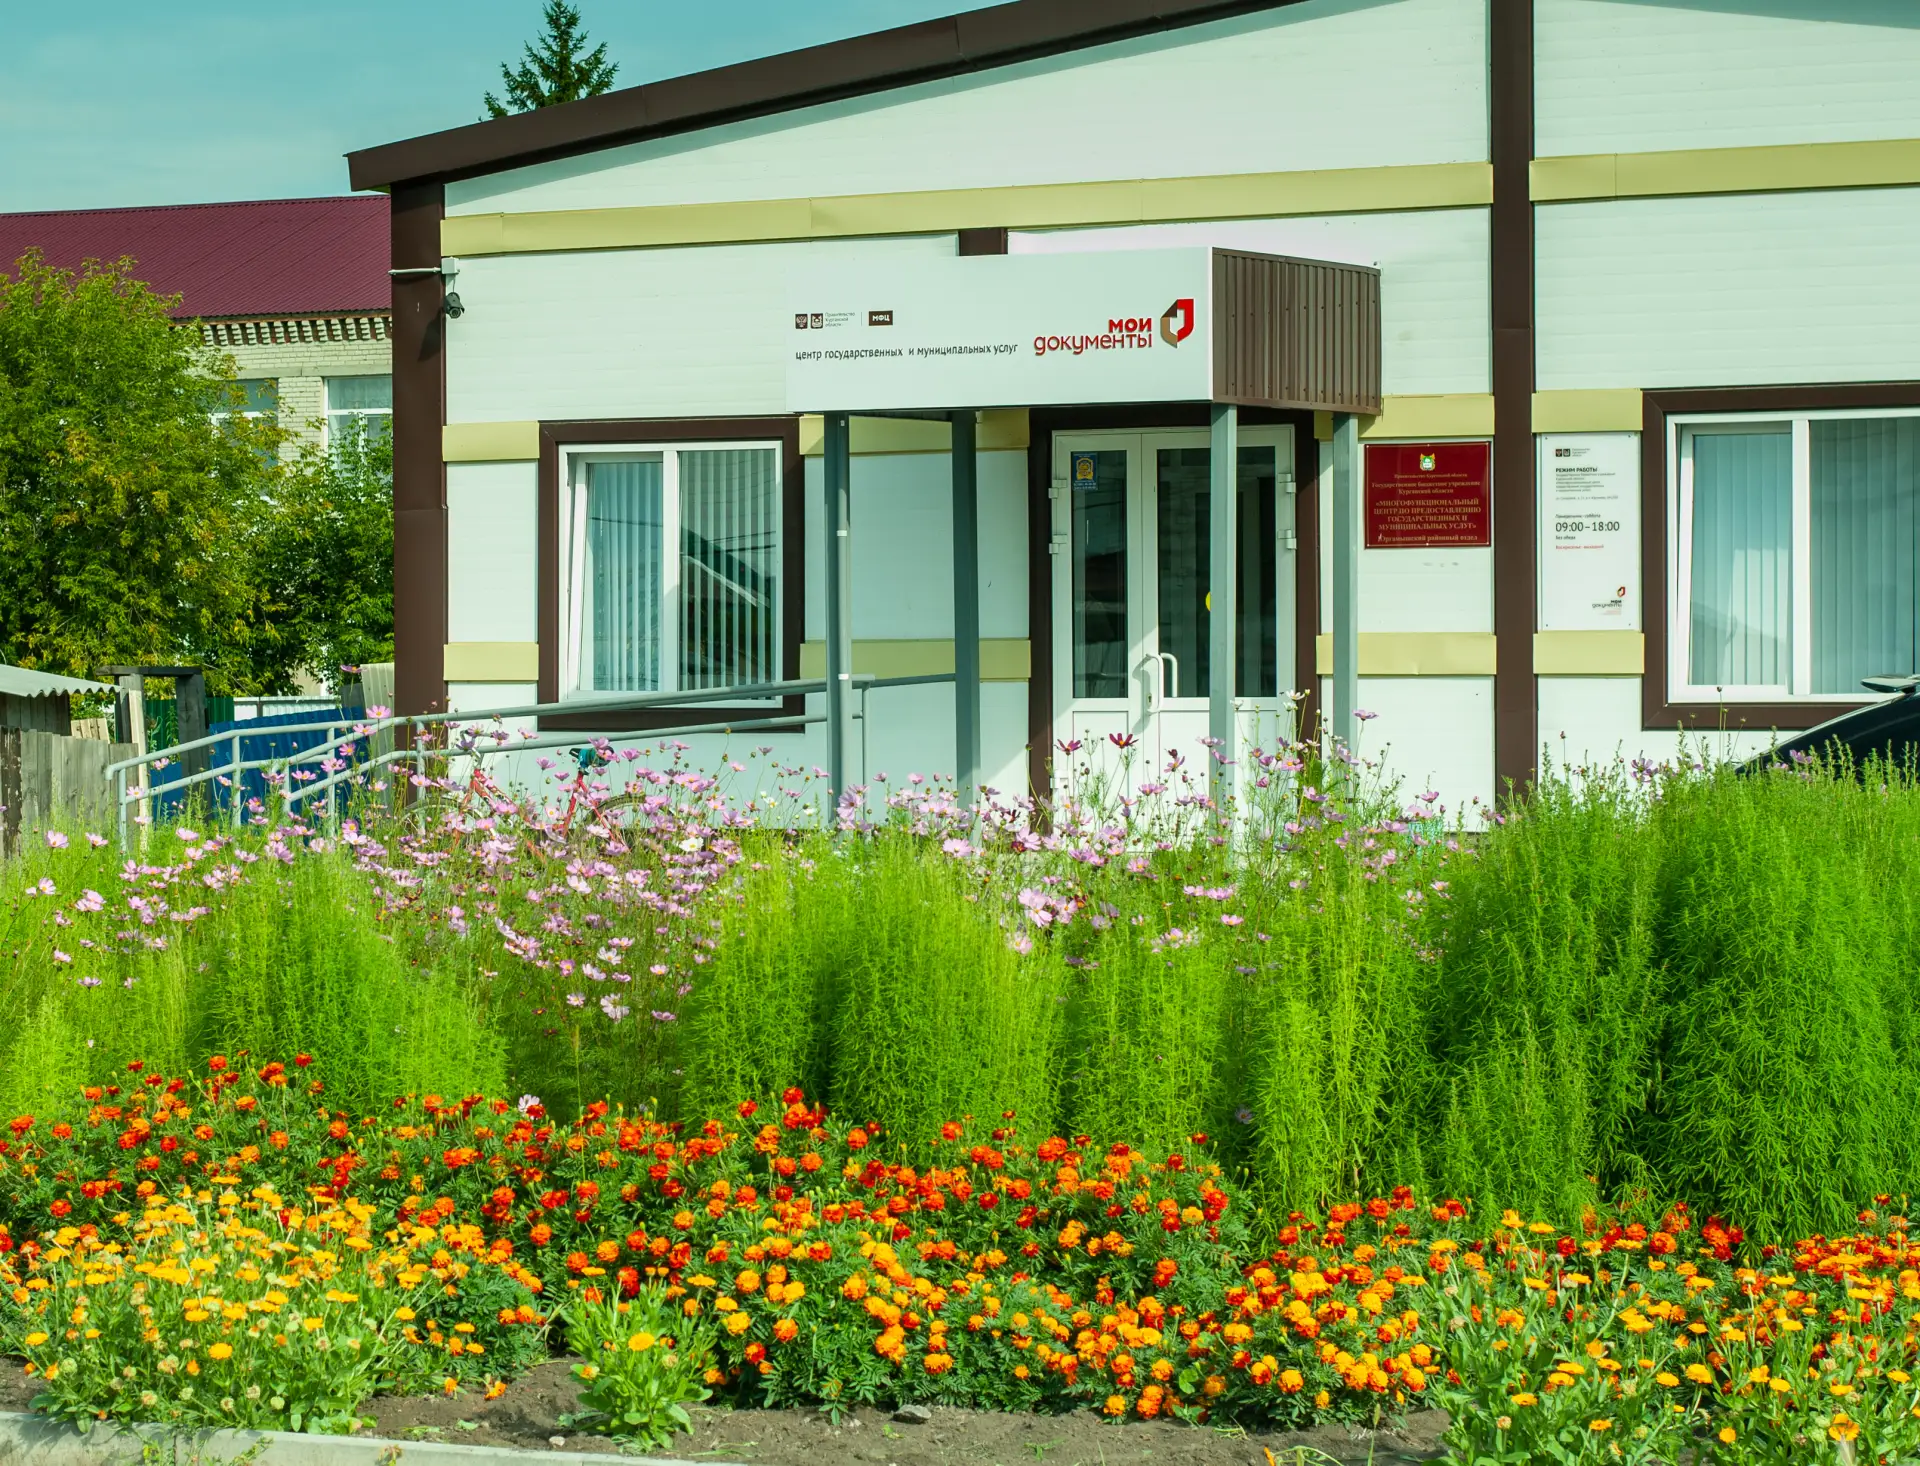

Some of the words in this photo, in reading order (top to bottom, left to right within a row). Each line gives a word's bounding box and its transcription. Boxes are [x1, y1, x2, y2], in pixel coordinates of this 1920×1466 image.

[796, 350, 822, 360] центр
[824, 347, 903, 360] государственных
[908, 347, 914, 356] и
[917, 344, 992, 358] муниципальных
[993, 344, 1018, 355] услуг
[1033, 333, 1152, 356] документы
